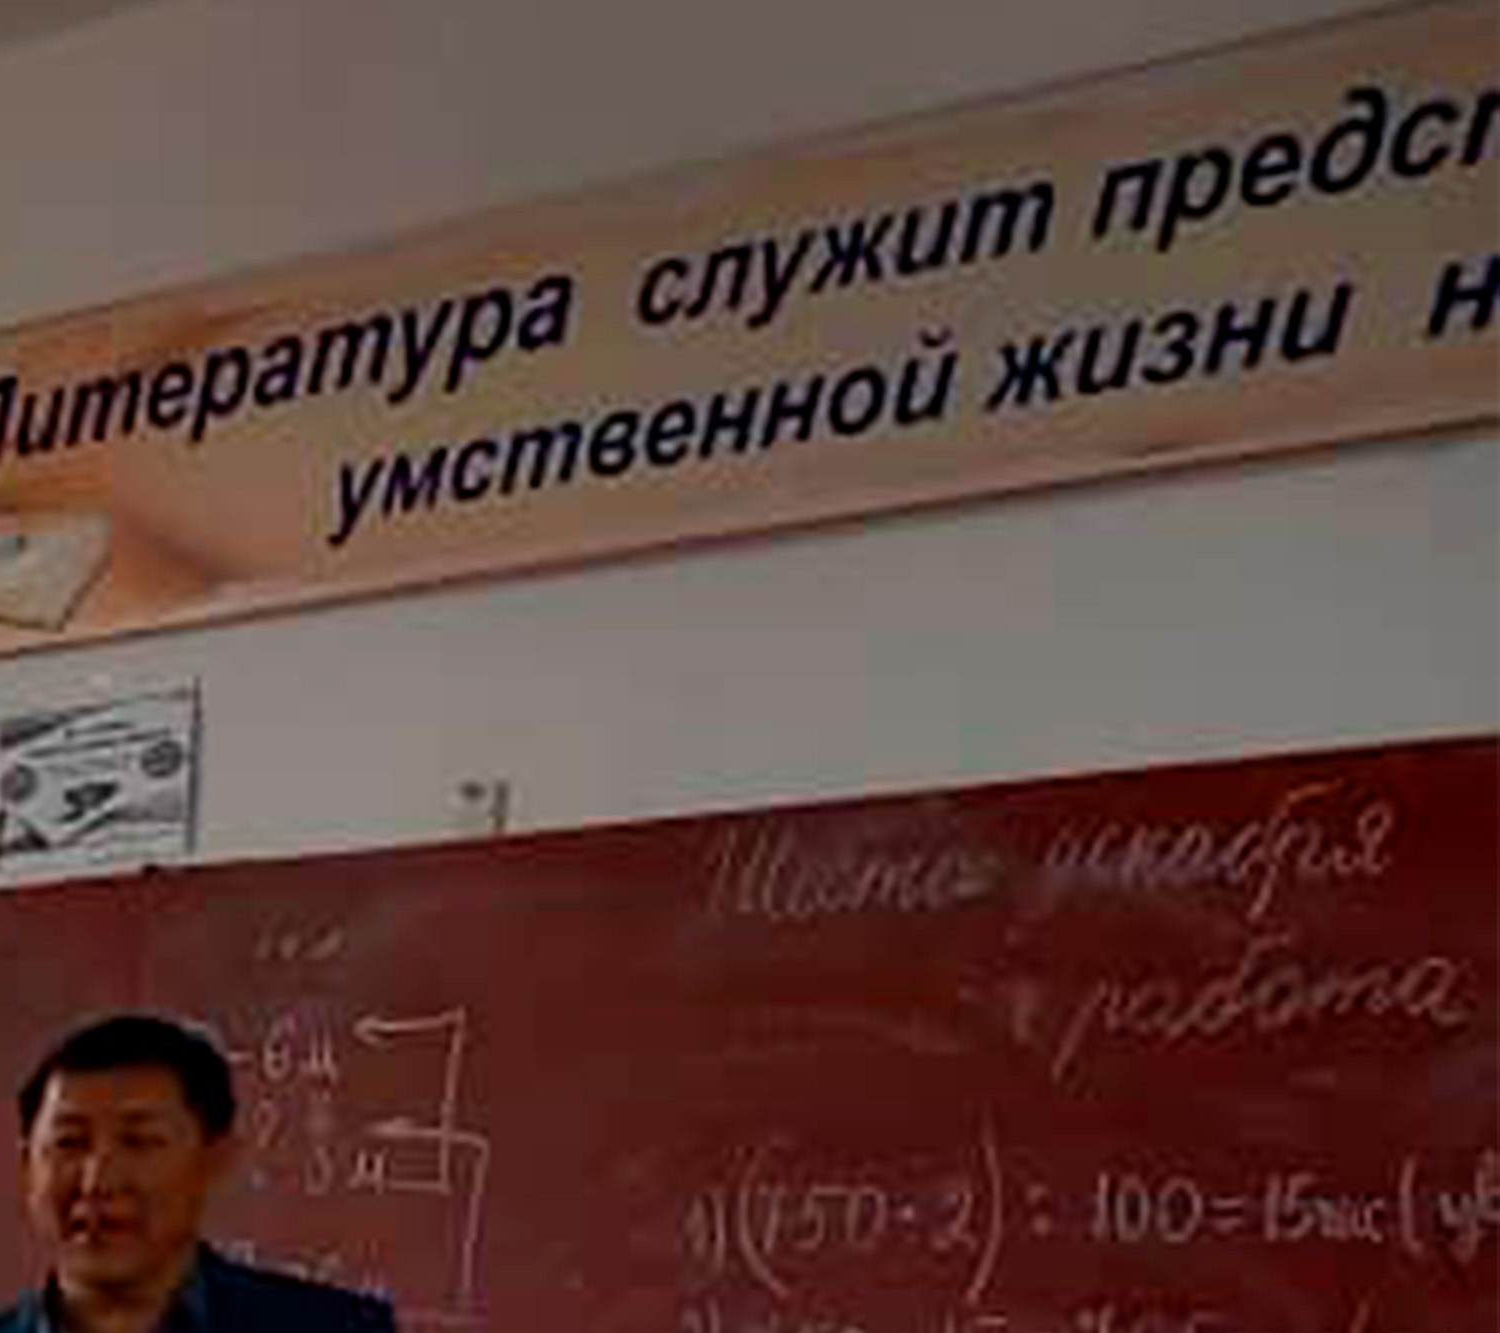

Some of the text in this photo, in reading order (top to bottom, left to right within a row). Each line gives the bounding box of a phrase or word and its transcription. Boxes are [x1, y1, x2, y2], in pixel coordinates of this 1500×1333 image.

[635, 179, 1057, 330] служит
[328, 327, 959, 547] умственной
[987, 281, 1355, 413] жизни
